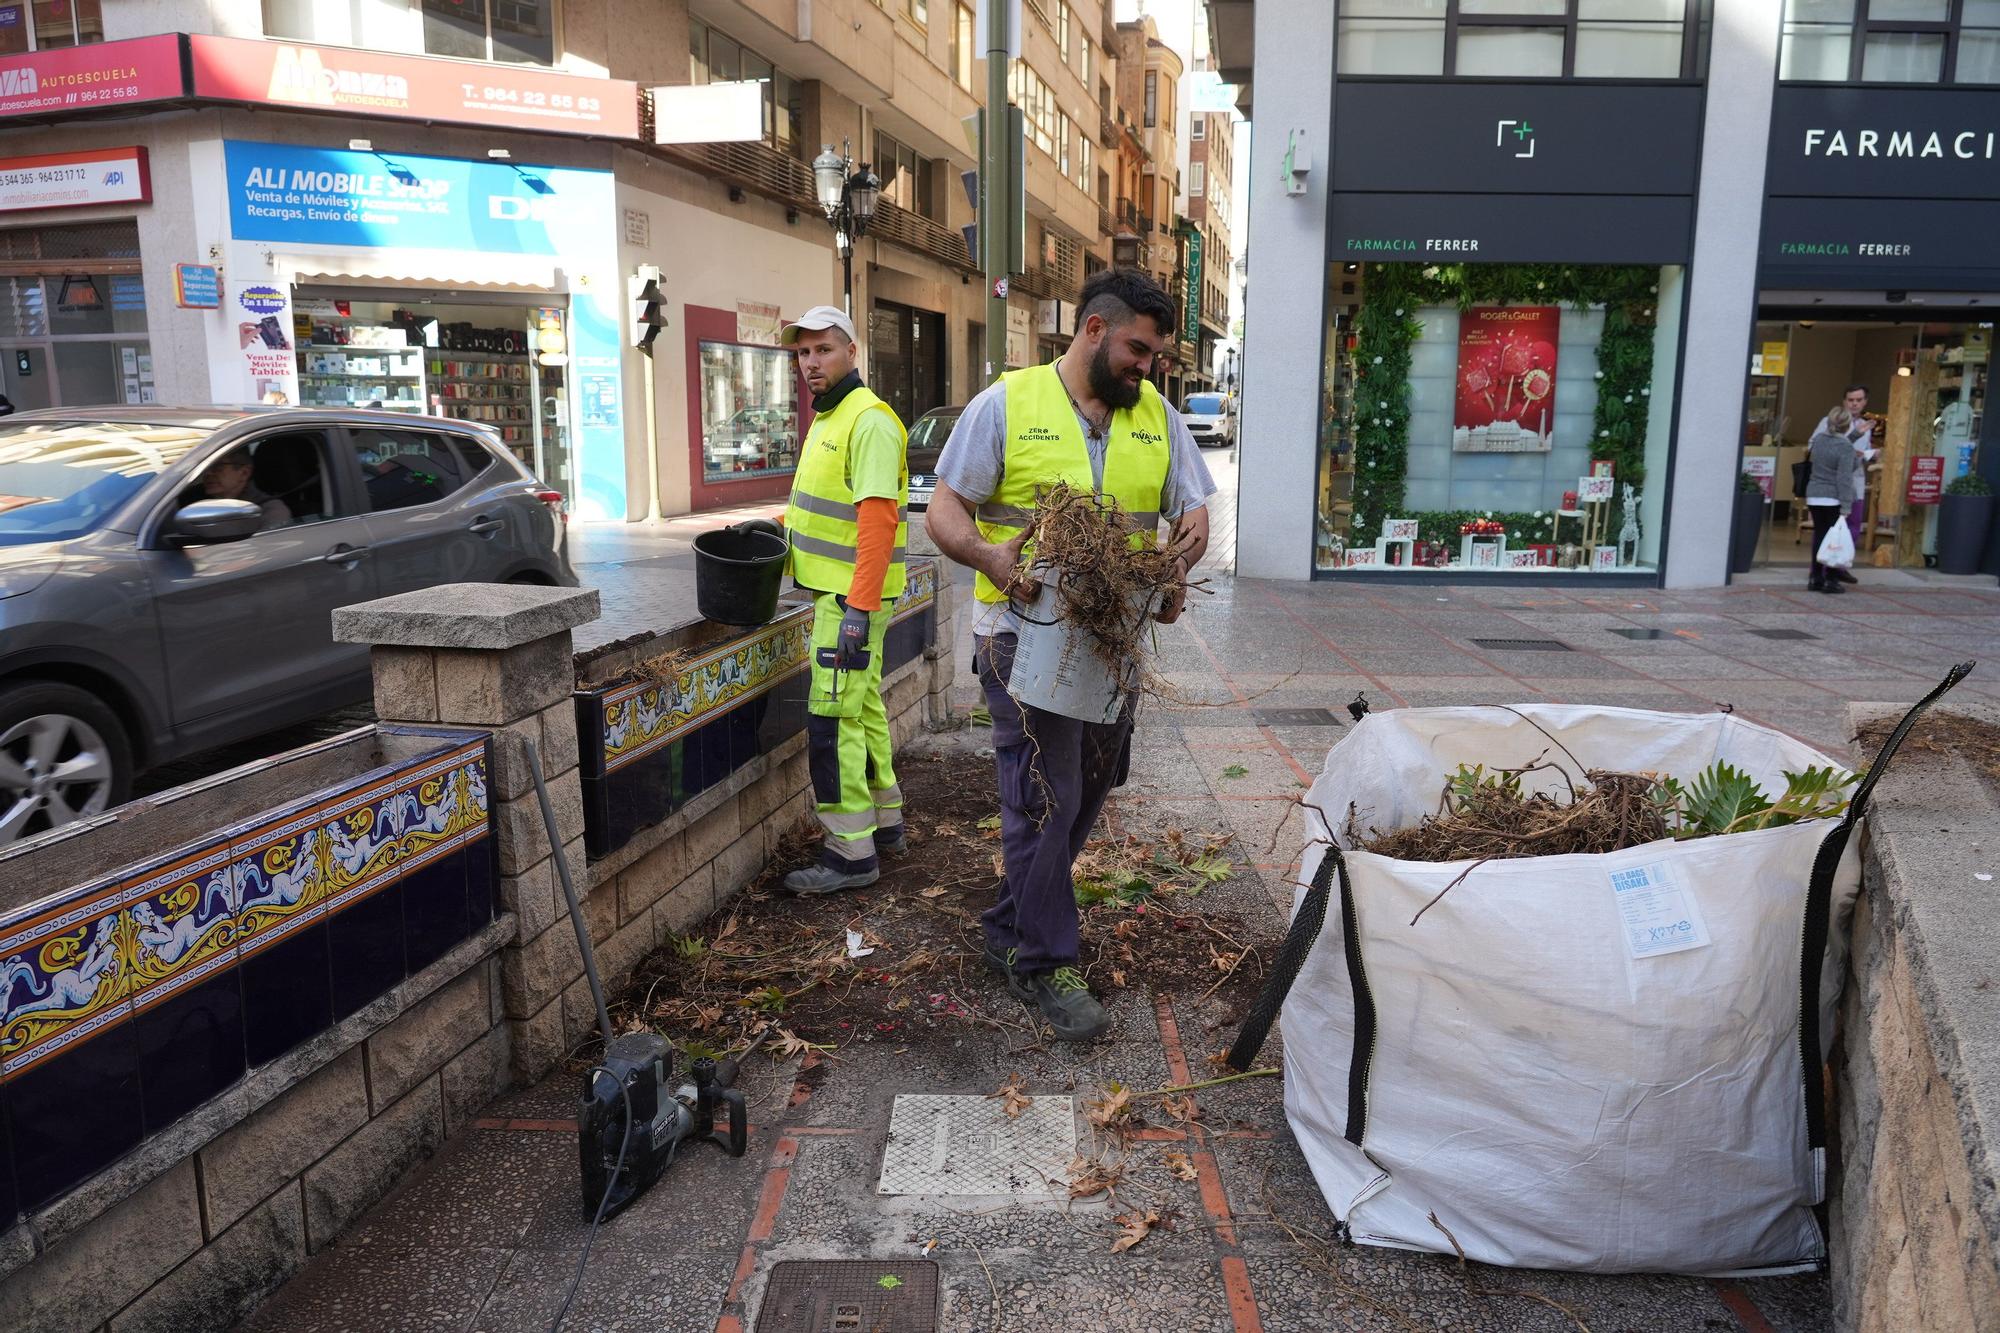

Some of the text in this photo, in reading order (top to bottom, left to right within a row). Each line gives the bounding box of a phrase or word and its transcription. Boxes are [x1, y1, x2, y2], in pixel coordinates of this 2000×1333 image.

[0, 67, 138, 97] za AUTOESCUELA
[81, 91, 97, 102] 964
[99, 89, 111, 100] 22
[113, 88, 124, 98] 55
[127, 86, 138, 97] 83
[334, 93, 409, 109] AUTOESCUELA
[523, 90, 546, 106] 22
[1804, 129, 1994, 159] FARMACI
[5, 173, 19, 186] 544
[20, 172, 34, 185] 365
[38, 171, 53, 183] 964
[54, 170, 64, 182] 23
[65, 169, 74, 180] 17
[76, 168, 86, 180] 12
[104, 171, 124, 186] API
[245, 167, 449, 200] ALI MOBILE SHOP
[246, 189, 282, 204] Venta
[285, 192, 300, 205] de
[303, 192, 349, 208] Móviles
[351, 199, 360, 211] y
[247, 205, 305, 222] Recargas,
[308, 208, 341, 222] Envío
[343, 209, 358, 222] de
[1347, 239, 1479, 251] FARMACIA FERRER
[1781, 243, 1911, 256] FARMACIA FERRER
[262, 299, 284, 307] Hora
[1611, 868, 1646, 883] BIG BAGS
[1614, 876, 1650, 892] DISAKA
